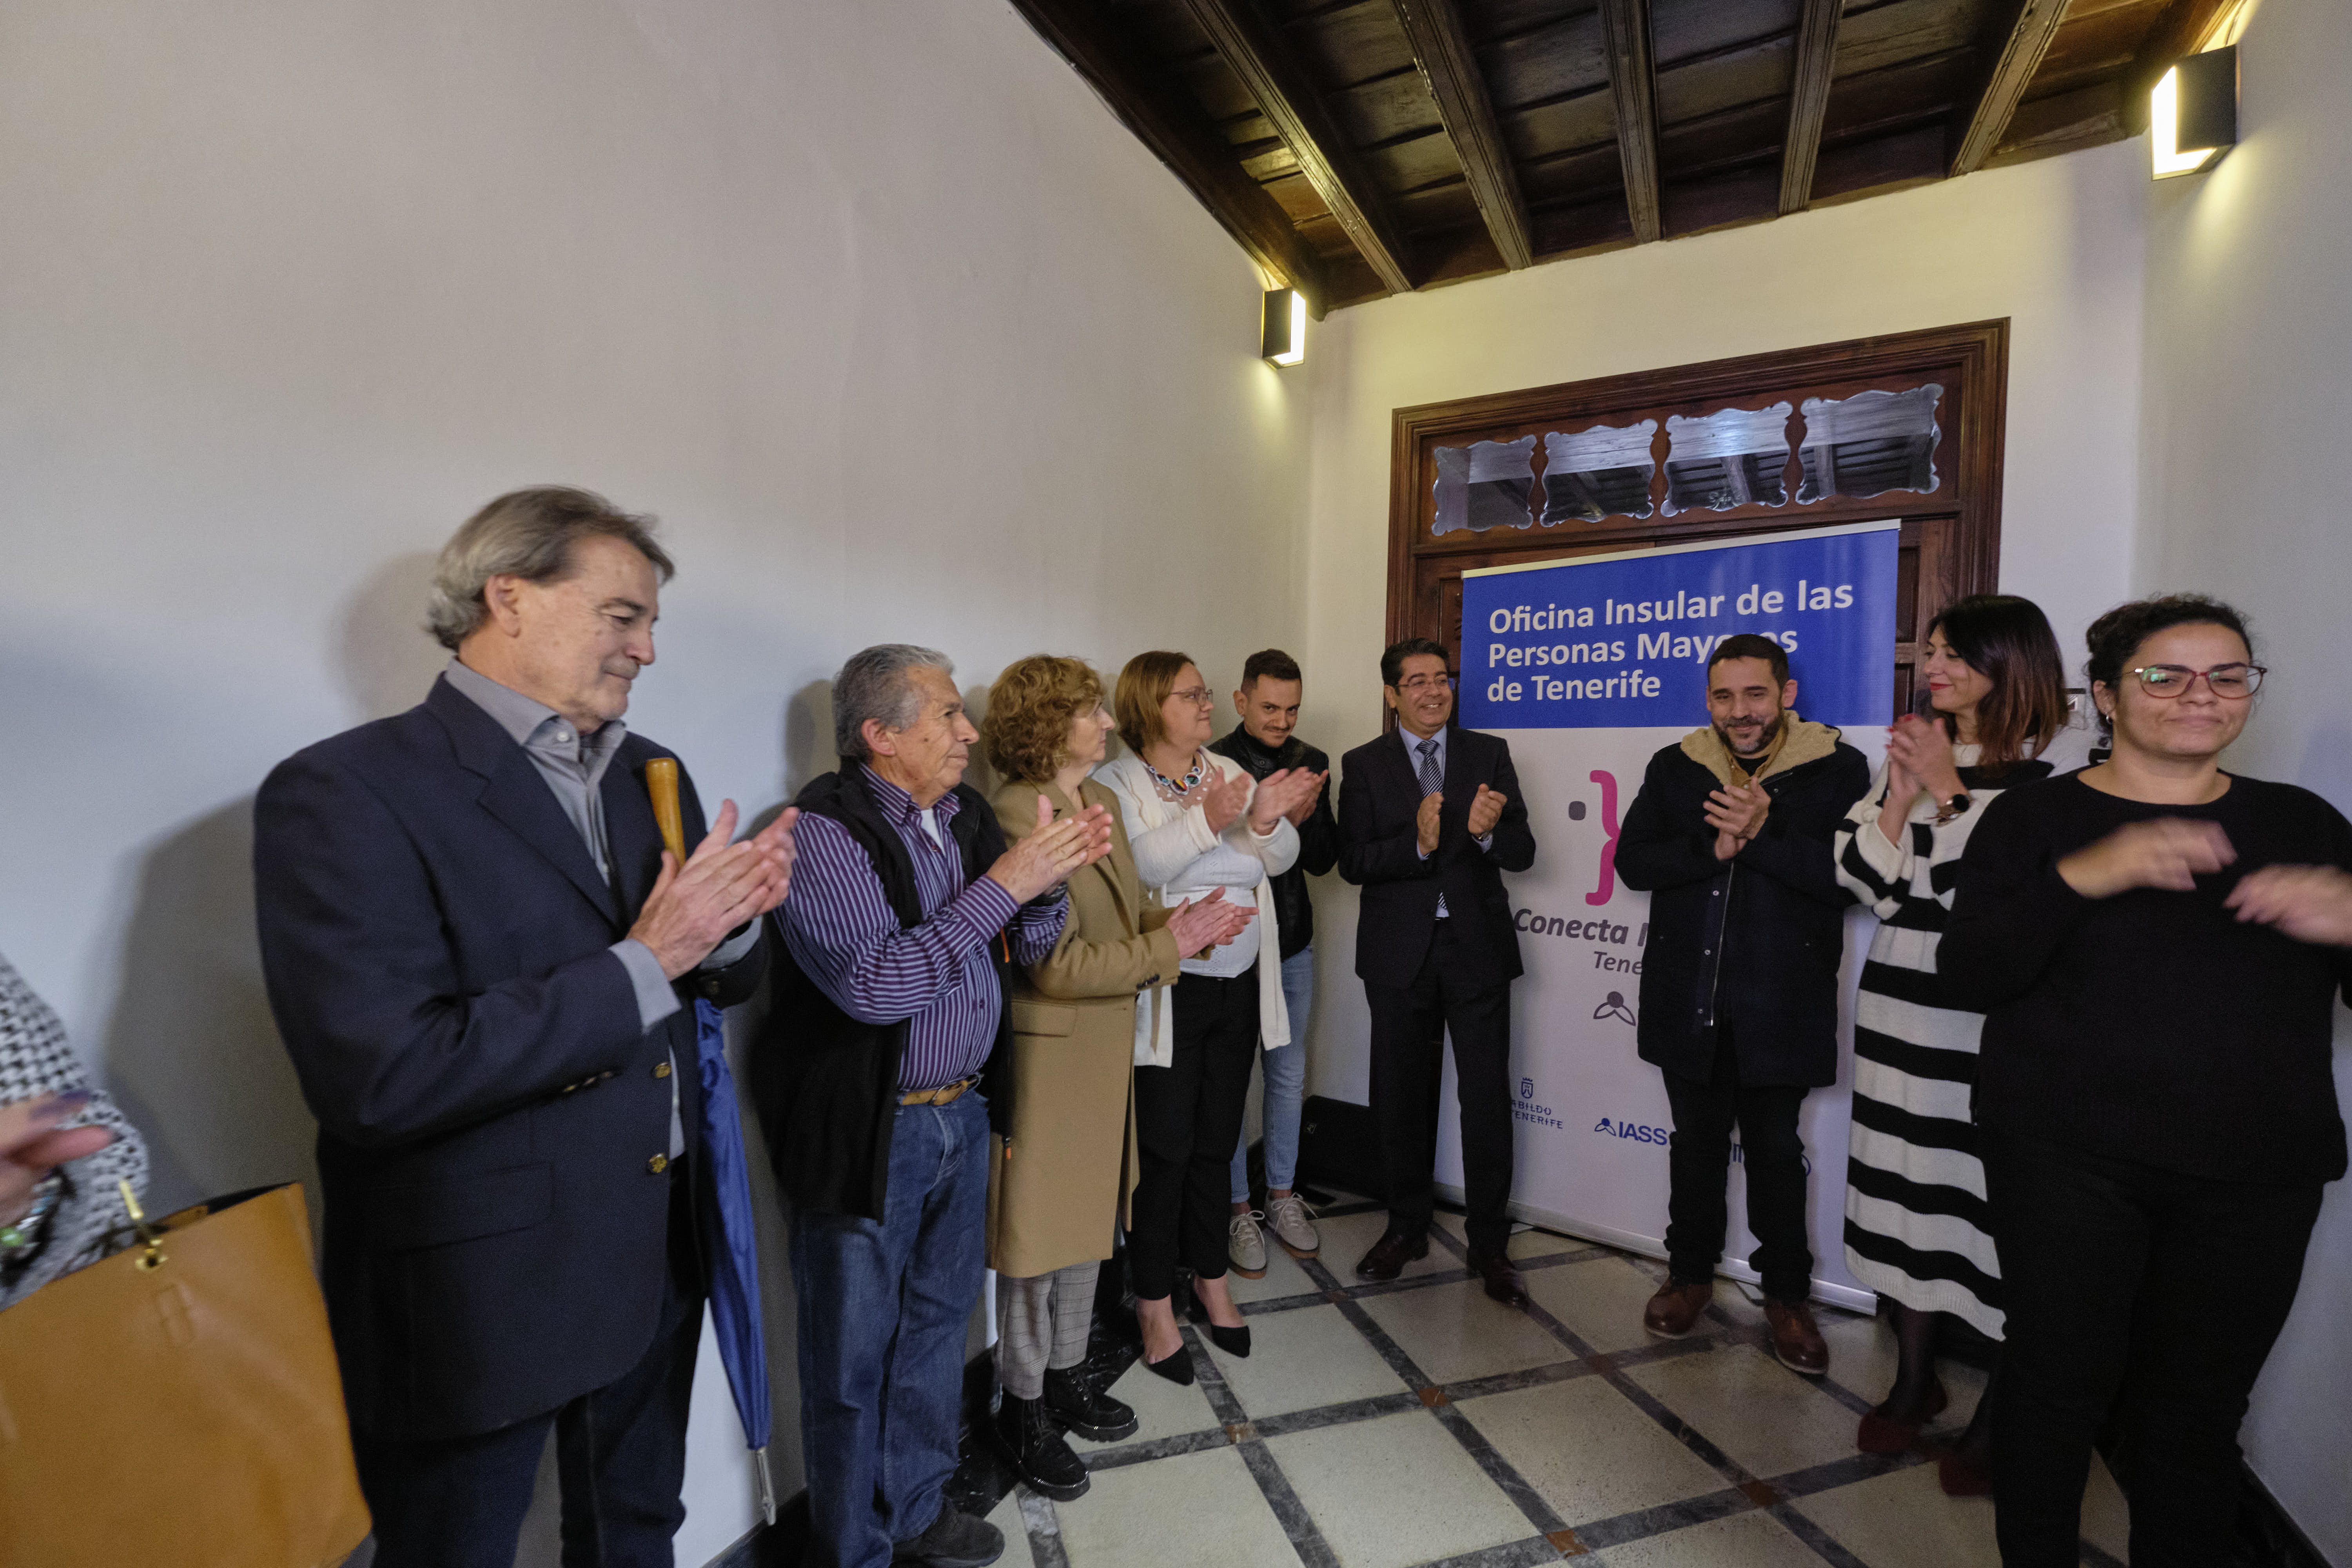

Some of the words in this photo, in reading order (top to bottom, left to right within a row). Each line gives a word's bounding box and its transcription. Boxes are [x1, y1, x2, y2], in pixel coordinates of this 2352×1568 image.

[1490, 603, 1593, 633] Oficina
[1606, 591, 1725, 625] Insular
[1736, 584, 1784, 615] de
[1798, 580, 1853, 611] las
[1489, 641, 1625, 668] Personas
[1637, 630, 1798, 664] Mays
[1487, 676, 1522, 702] de
[1531, 669, 1661, 701] Tenerife
[1514, 908, 1629, 944] Conecta
[1512, 1110, 1563, 1129] ENERIFE
[1619, 1122, 1668, 1145] IASS
